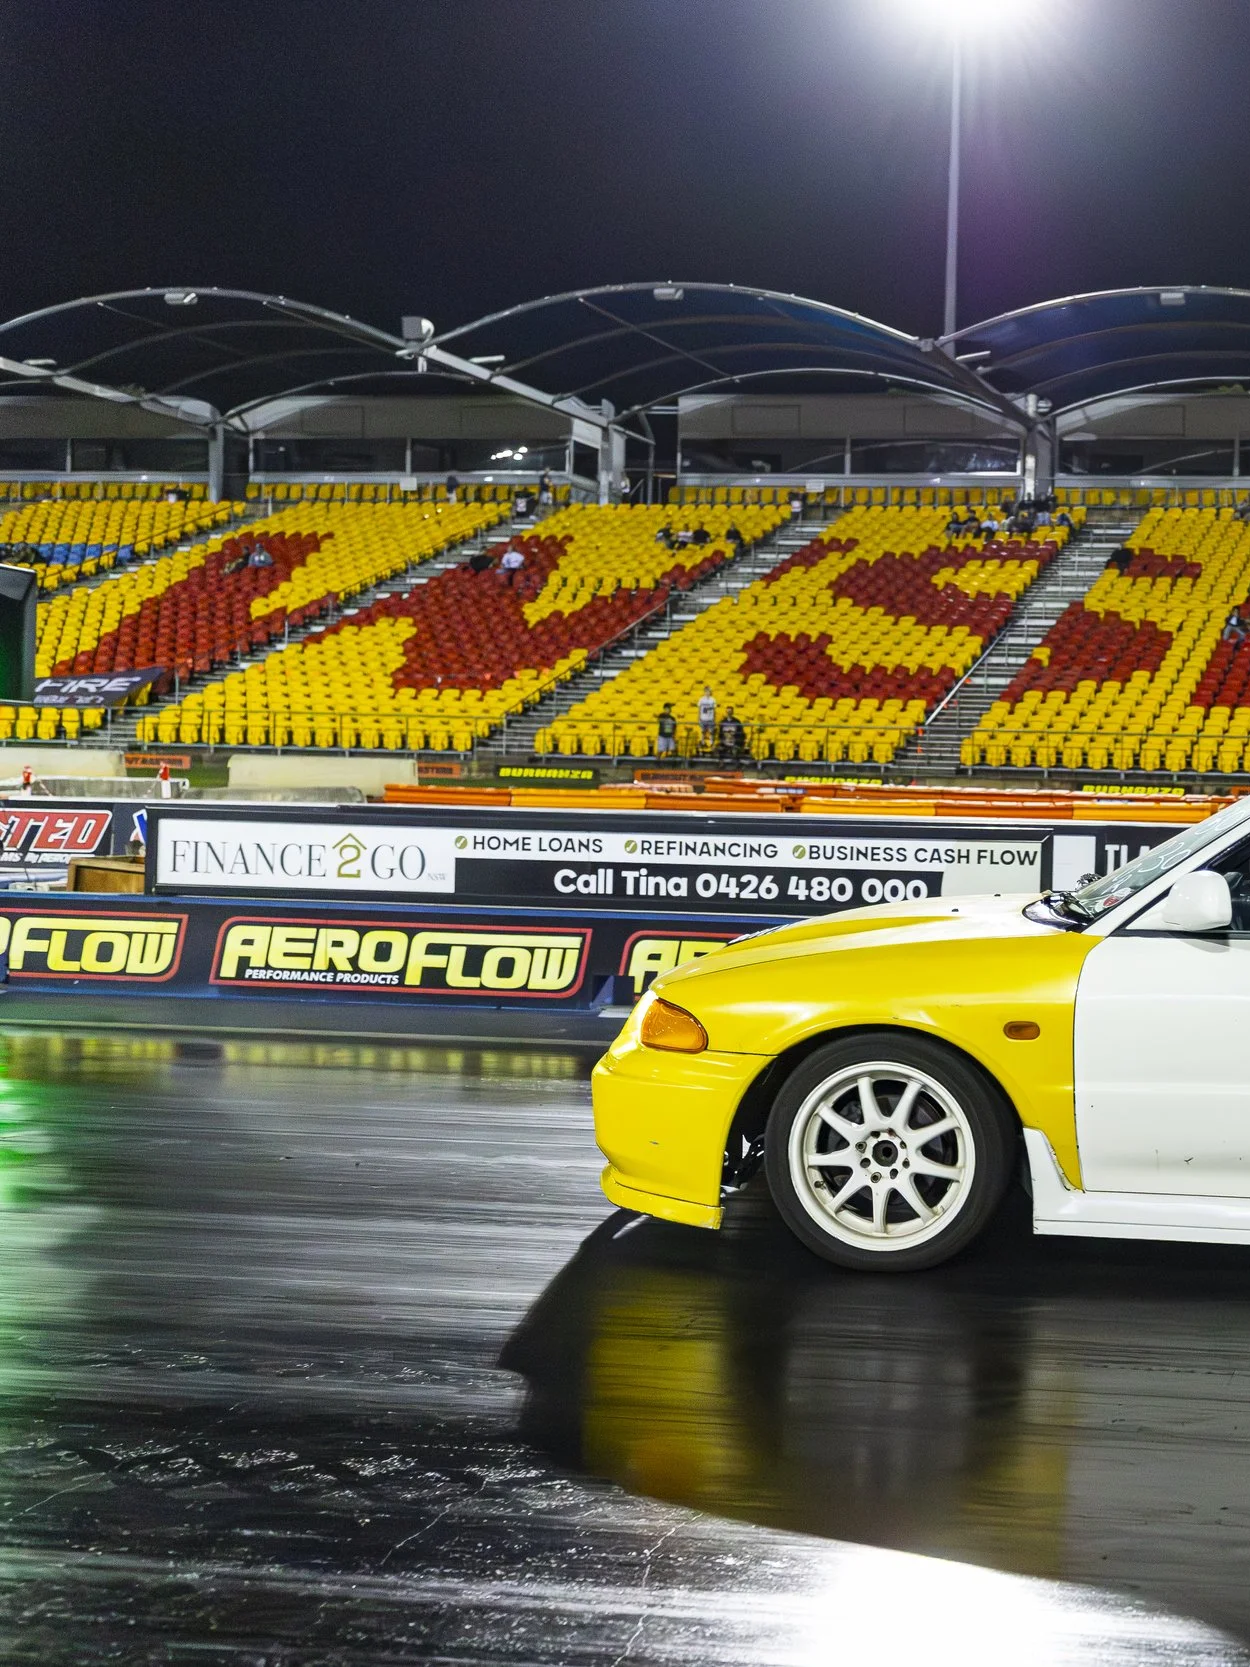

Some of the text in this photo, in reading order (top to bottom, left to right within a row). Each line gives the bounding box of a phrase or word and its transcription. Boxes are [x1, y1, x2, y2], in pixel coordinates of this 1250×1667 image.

[473, 835, 603, 853] HOME LOANS
[641, 840, 778, 858] REFINANCING
[809, 844, 1038, 866] BUSINESS CASH FLOW
[554, 868, 928, 903] Call Tina 0426 480 000
[219, 925, 583, 990] AEROFLOW
[244, 968, 399, 985] PERFORMANCE PRODUCTS
